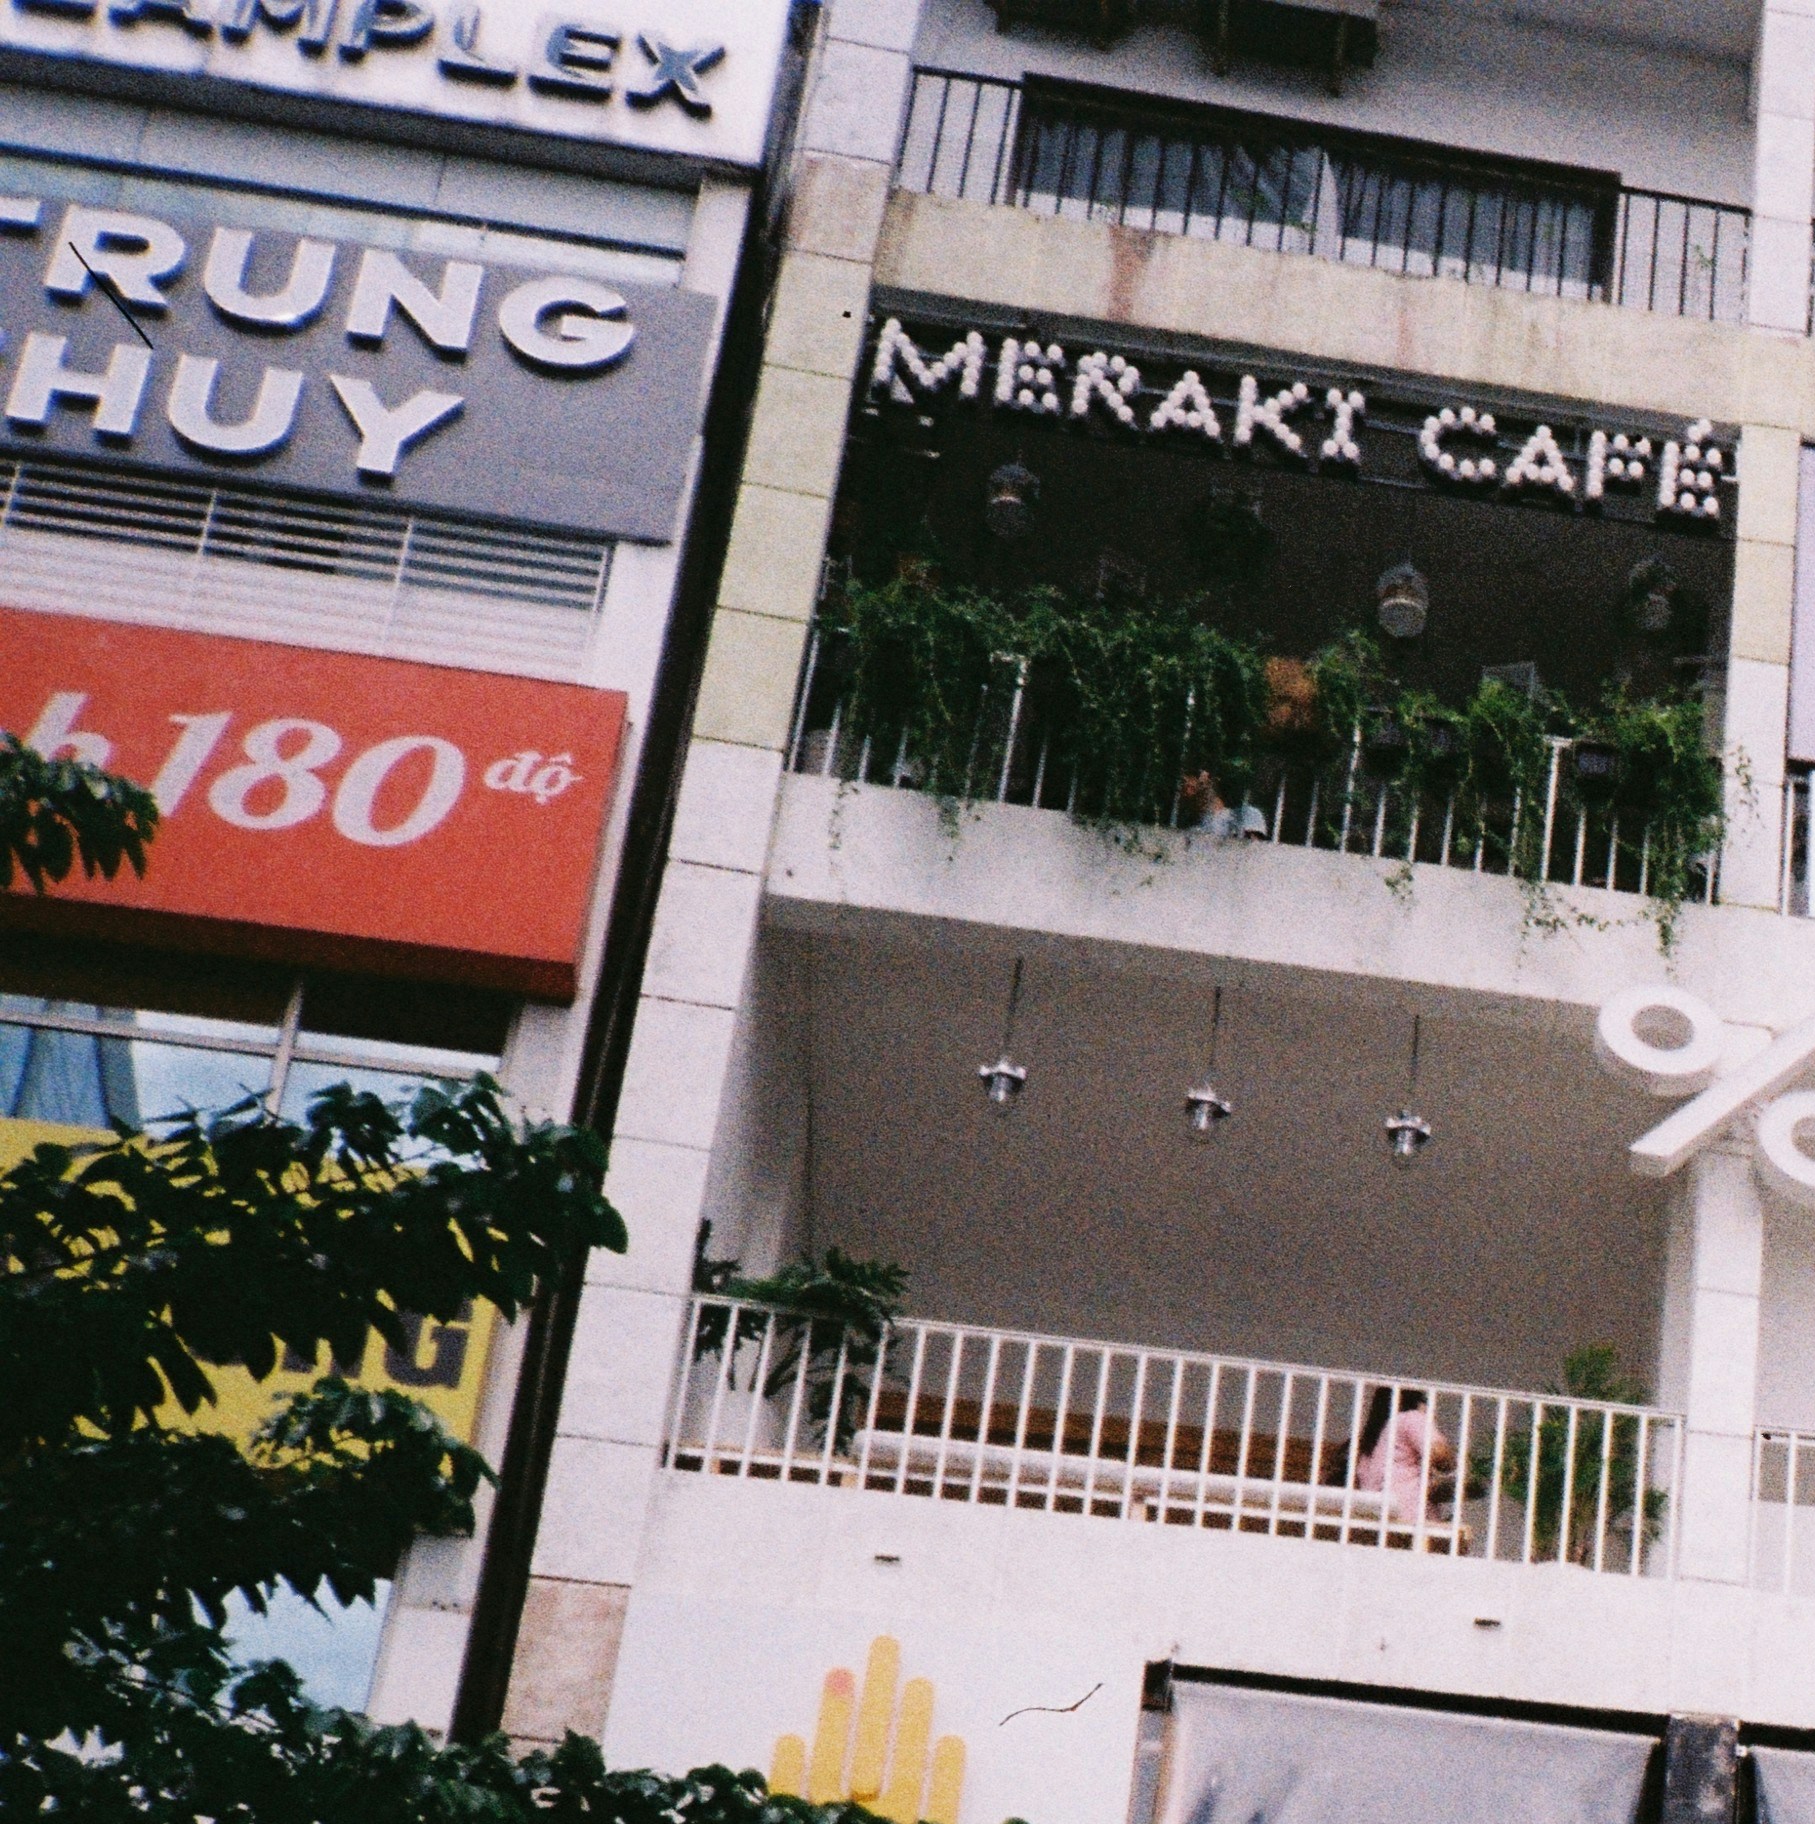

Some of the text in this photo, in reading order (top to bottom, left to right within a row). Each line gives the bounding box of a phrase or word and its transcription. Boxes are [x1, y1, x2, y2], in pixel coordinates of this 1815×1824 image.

[5, 0, 727, 118] MPLEX
[5, 333, 465, 484] HUY
[871, 317, 1364, 472] MERAKI
[150, 709, 468, 848] 180
[482, 748, 583, 804] độ
